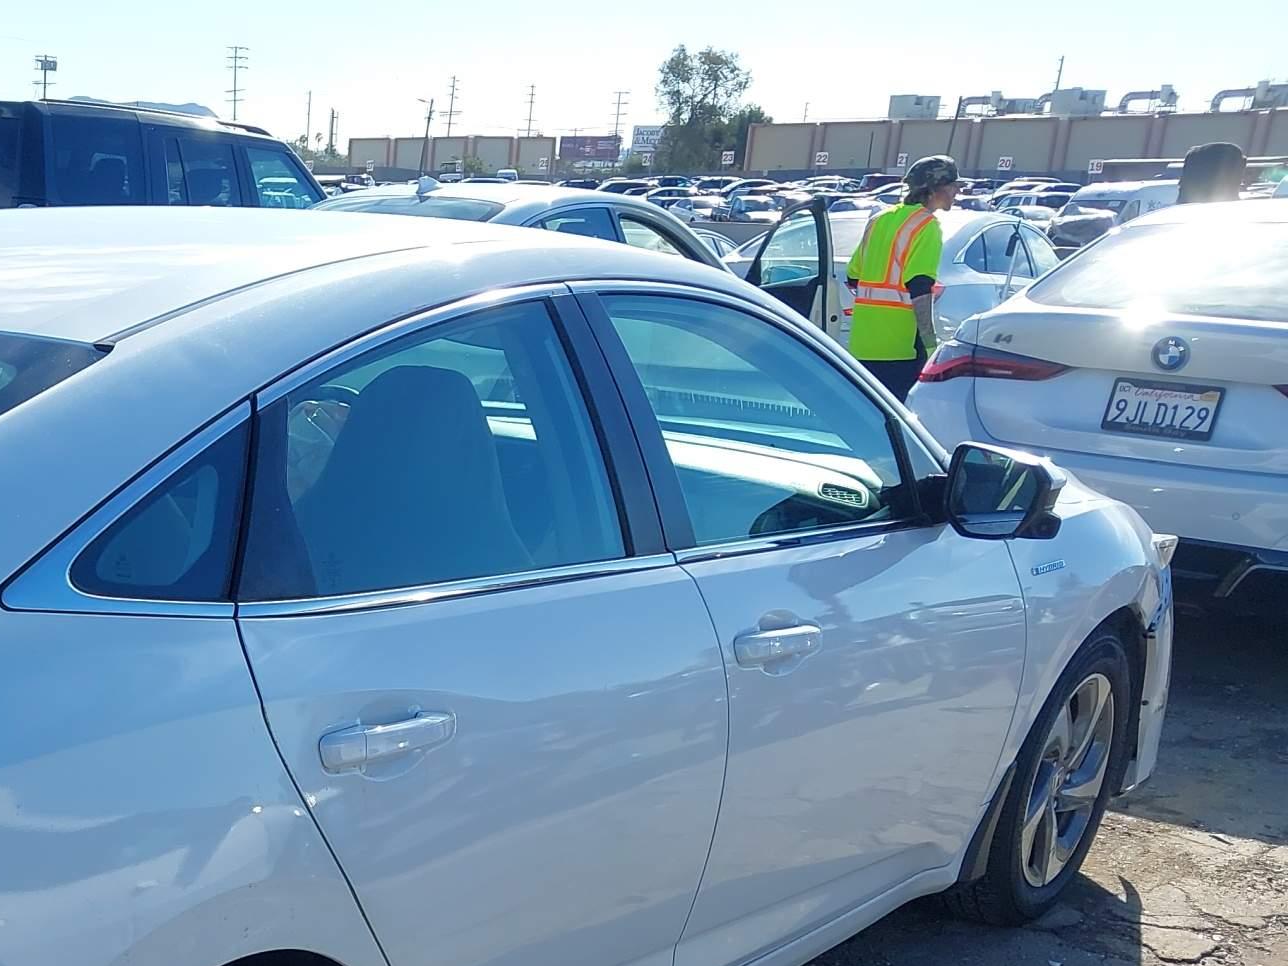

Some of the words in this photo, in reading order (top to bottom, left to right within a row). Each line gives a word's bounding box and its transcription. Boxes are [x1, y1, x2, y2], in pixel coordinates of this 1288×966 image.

[816, 154, 828, 163] 22
[999, 158, 1011, 168] 20
[1090, 162, 1102, 172] 19
[1111, 398, 1210, 431] 9JLD129
